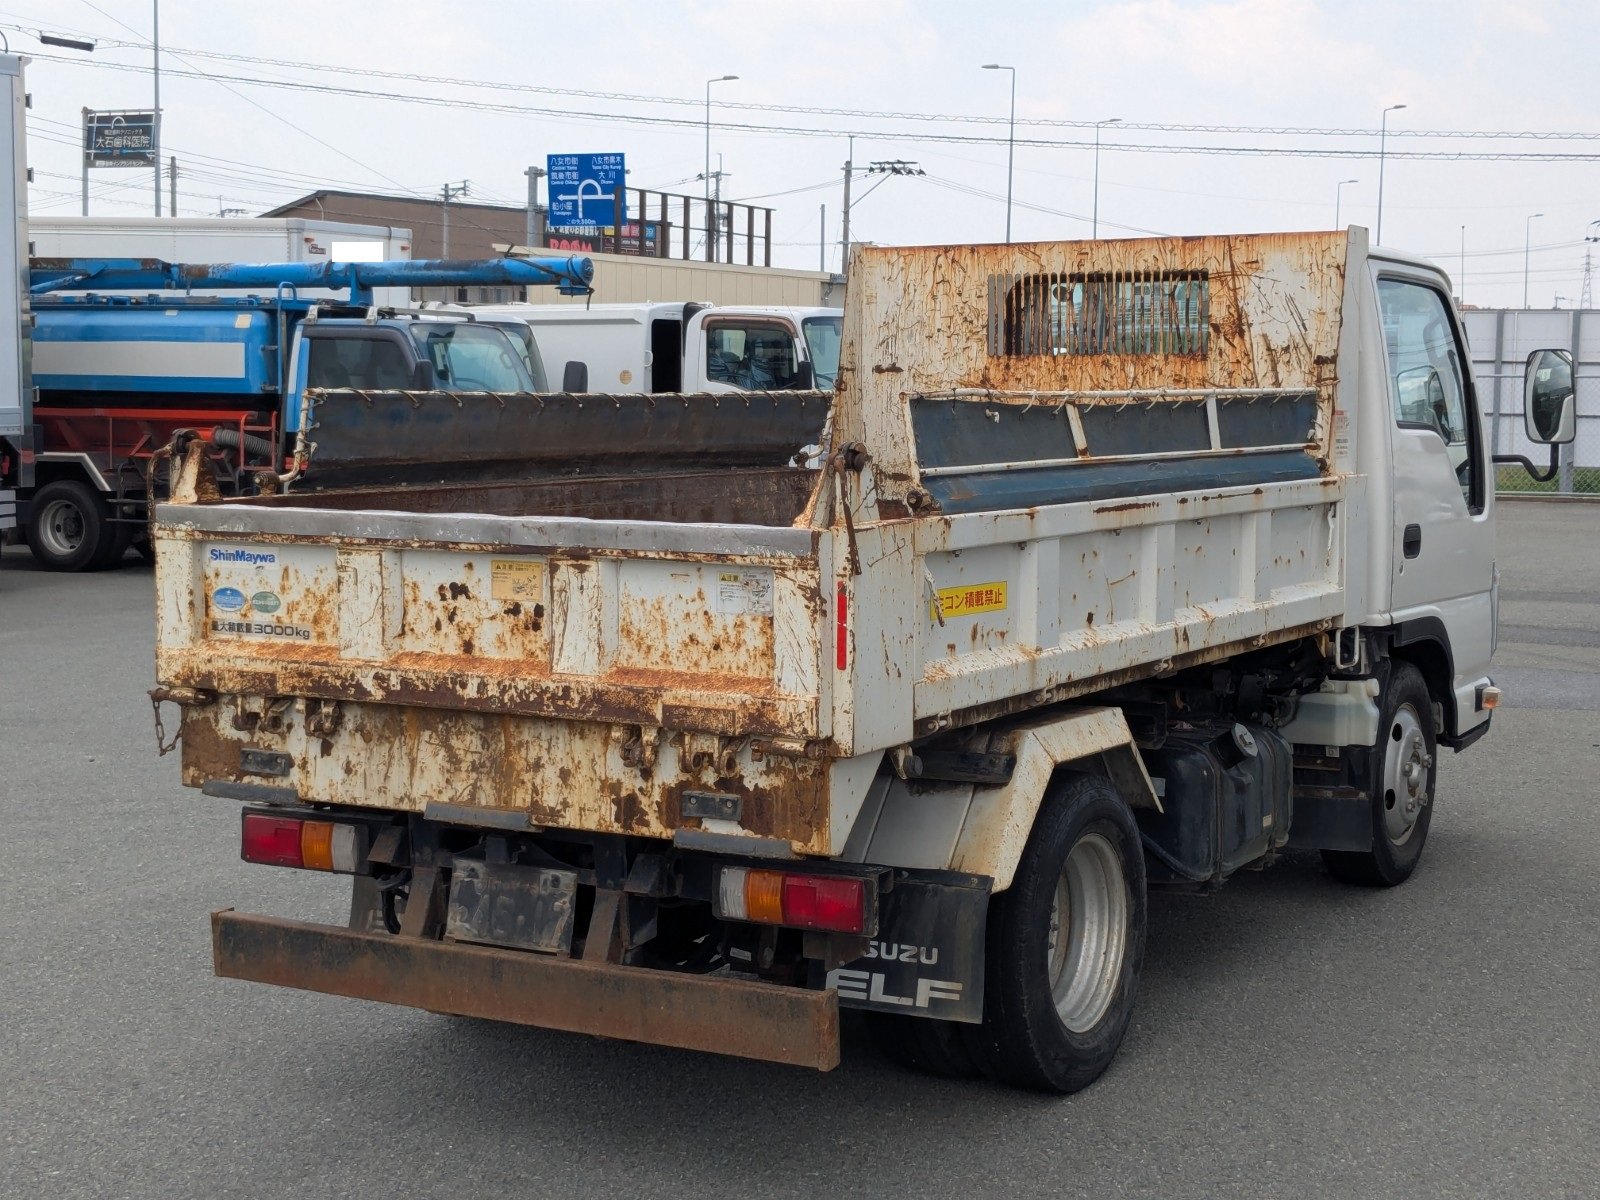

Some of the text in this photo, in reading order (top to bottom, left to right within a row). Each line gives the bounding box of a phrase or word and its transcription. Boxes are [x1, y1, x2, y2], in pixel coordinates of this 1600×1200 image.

[96, 136, 150, 148] 大石歯科医院
[550, 157, 579, 165] 八女市街
[591, 156, 622, 165] 八女市黒木
[550, 171, 579, 180] 筑後市街
[598, 171, 616, 180] 大川
[210, 548, 276, 564] ShinMaywa
[864, 940, 939, 965] SUZU
[825, 968, 963, 1008] ELF
